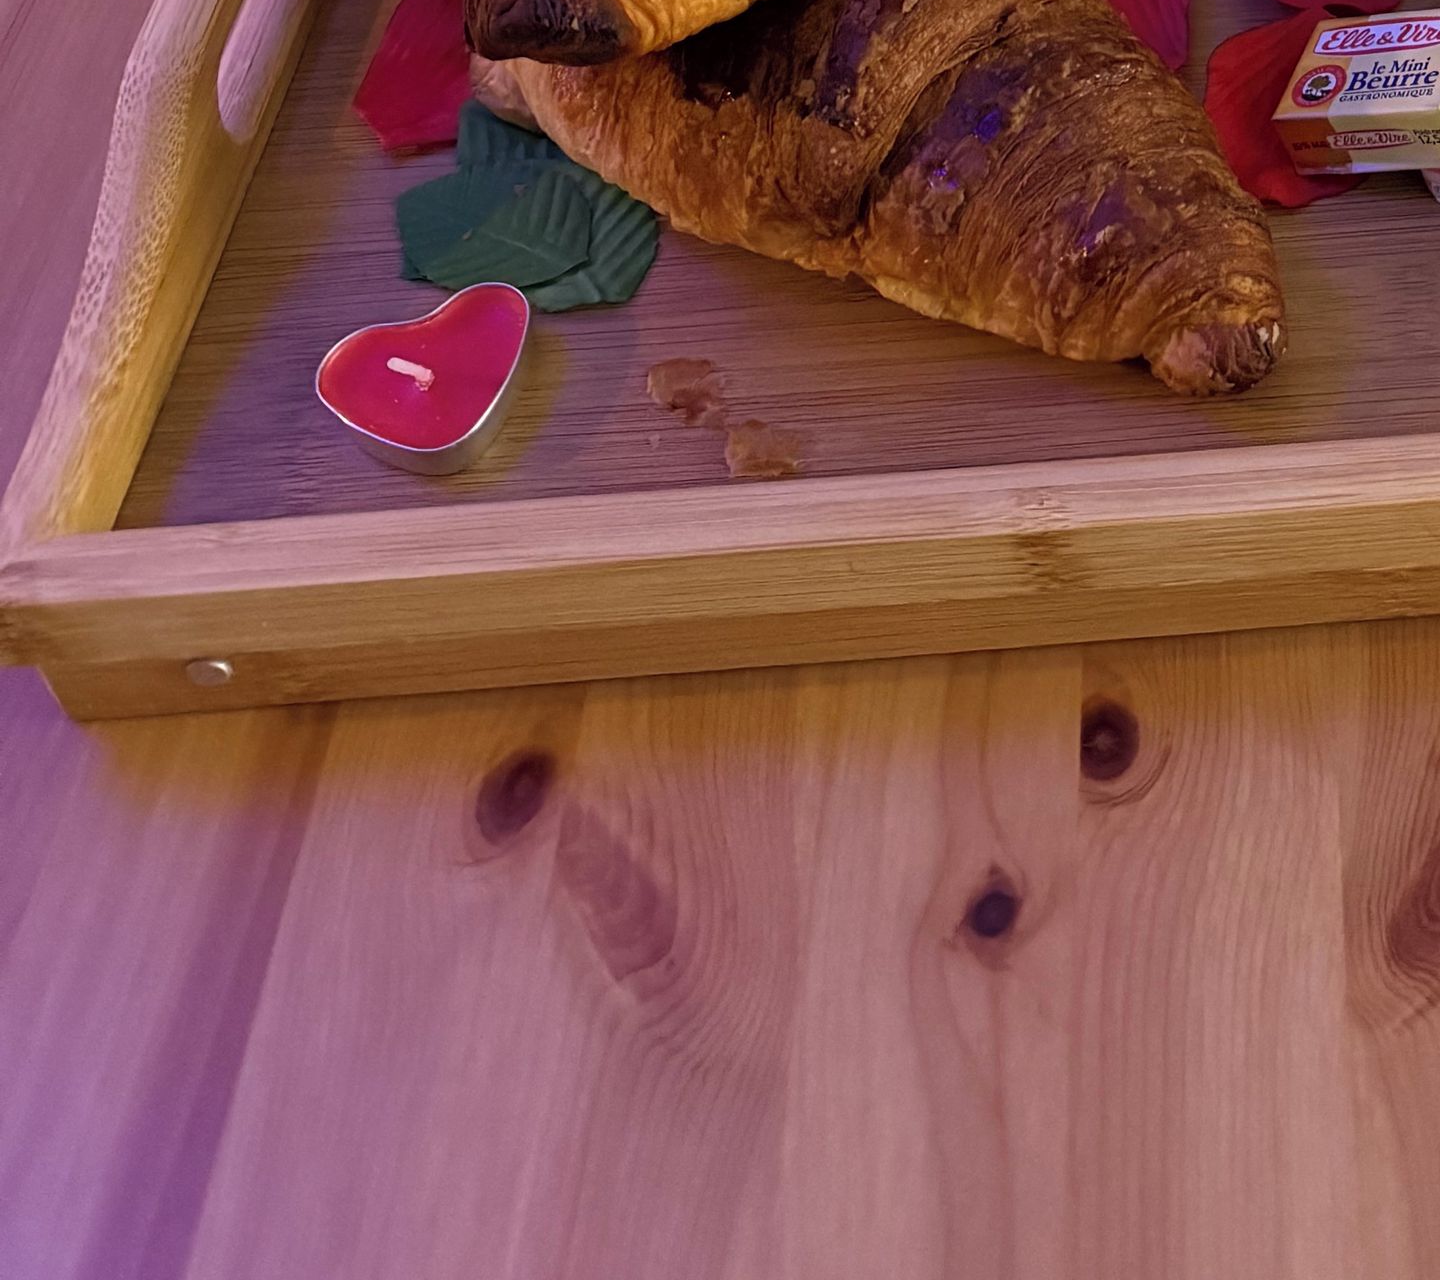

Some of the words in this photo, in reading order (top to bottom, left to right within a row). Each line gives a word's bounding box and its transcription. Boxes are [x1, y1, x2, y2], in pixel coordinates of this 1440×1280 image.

[1321, 29, 1376, 51] Elle
[1376, 30, 1395, 46] &
[1371, 61, 1386, 75] le
[1389, 57, 1432, 74] Mini
[1346, 70, 1440, 92] Beurre
[1339, 88, 1434, 103] GASTRONOMIQUE
[1333, 134, 1367, 147] Elle
